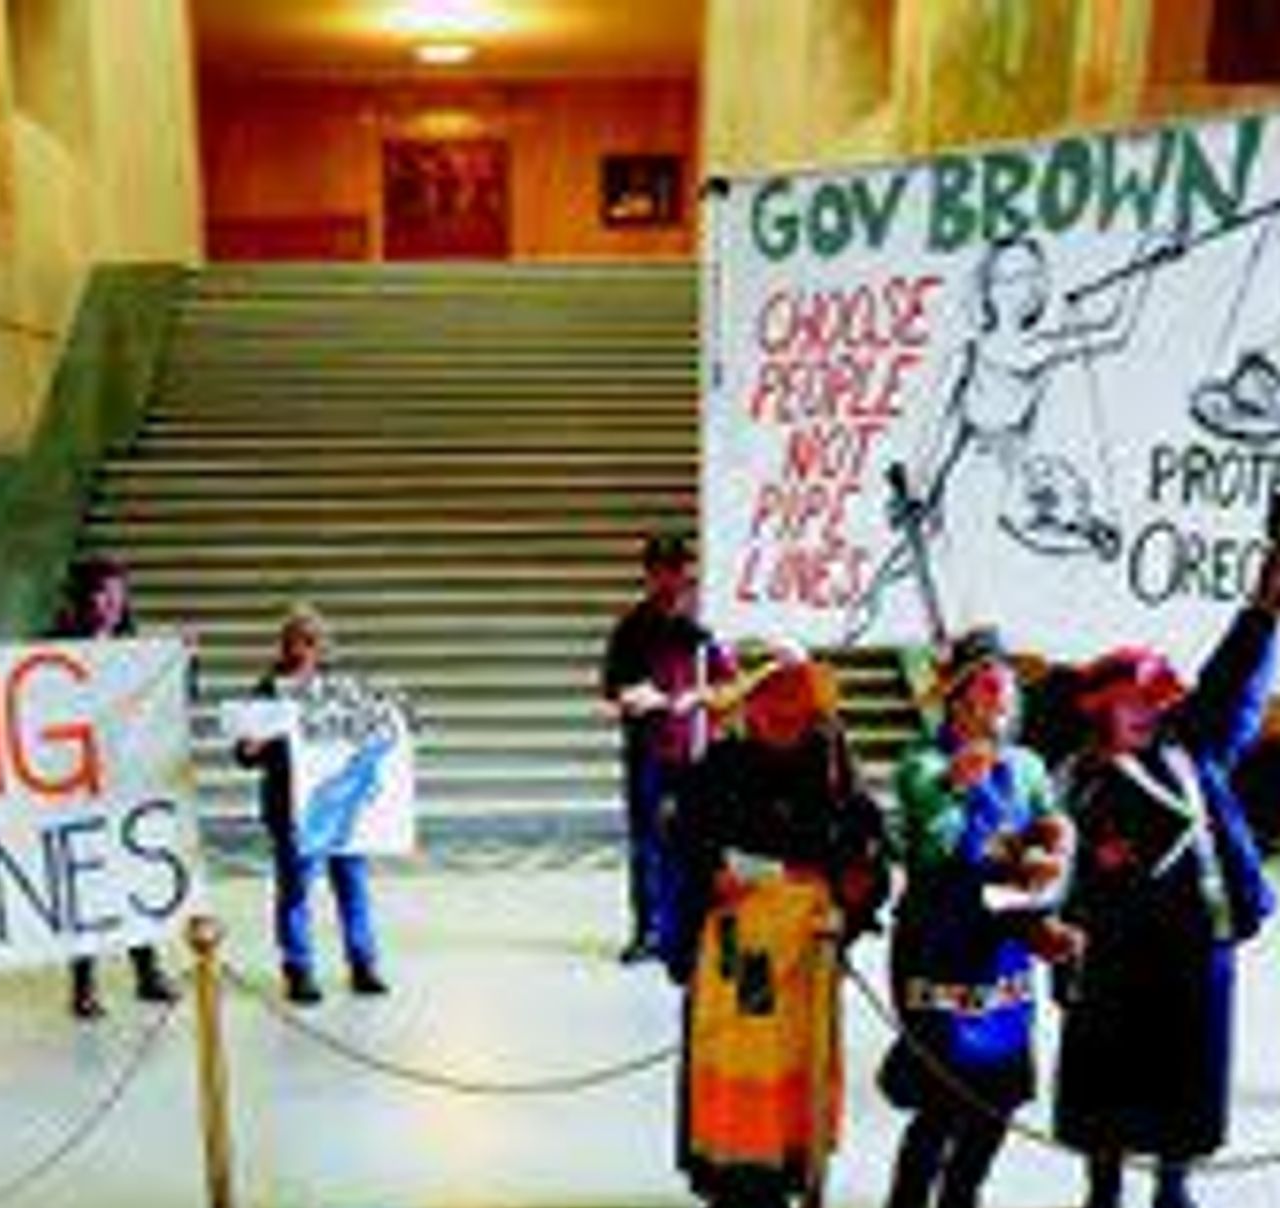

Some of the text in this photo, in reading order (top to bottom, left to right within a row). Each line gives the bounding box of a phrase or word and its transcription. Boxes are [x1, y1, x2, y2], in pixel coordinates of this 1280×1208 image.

[750, 116, 1266, 260] GOV BROWN
[758, 273, 942, 356] CHOOSE
[750, 352, 925, 424] PEOPLE
[782, 422, 885, 480] NOT
[752, 482, 860, 552] PIPE
[734, 543, 870, 609] LINES
